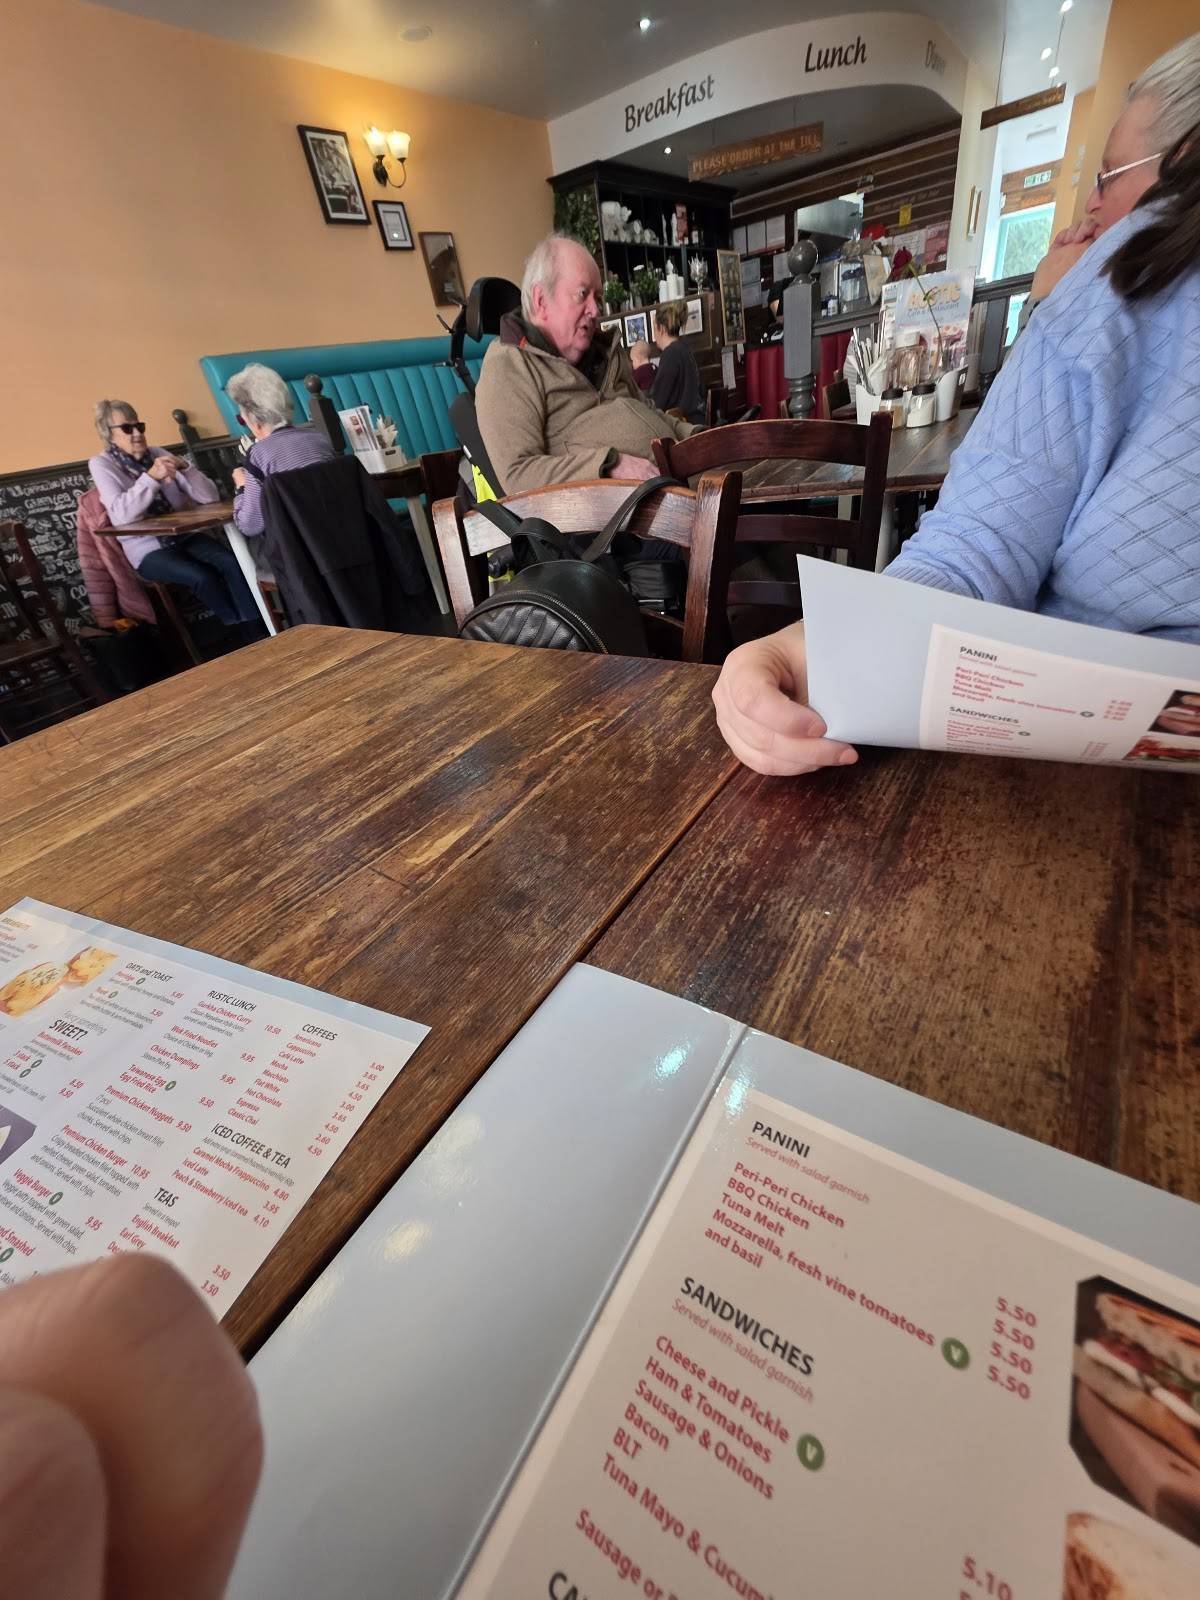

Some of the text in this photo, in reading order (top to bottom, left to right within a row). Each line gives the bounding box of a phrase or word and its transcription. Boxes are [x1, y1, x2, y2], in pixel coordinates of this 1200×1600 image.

[804, 36, 867, 73] Lunch
[624, 74, 715, 133] Breakfast
[692, 154, 727, 173] PLEASE
[960, 646, 998, 661] PANINI
[949, 706, 1020, 724] SANDWICHES
[152, 970, 174, 983] TOAST
[208, 990, 257, 1012] RUSTIC LUNCH
[215, 1007, 238, 1019] Chicken
[236, 1014, 253, 1025] Curry
[264, 1024, 283, 1035] 10.50
[49, 1019, 88, 1041] SWEET?
[294, 1034, 322, 1048] Americano
[302, 1023, 338, 1042] COFFEES
[150, 1044, 236, 1085] Chicken Dumplings 9.95
[240, 1052, 256, 1063] 9.95
[286, 1042, 378, 1081] Cappuccino 3.65
[290, 1054, 305, 1065] Latte
[355, 1081, 370, 1091] 3.65
[119, 1072, 215, 1108] Egg Fried Rice 9.50
[154, 1075, 167, 1088] Egg
[254, 1078, 347, 1122] Flat White 3.65
[262, 1069, 355, 1112] Macchiato 3.00
[270, 1059, 363, 1101] Mocha 4.50
[105, 1085, 193, 1133] Premium Chicken Nuggets 9.50
[236, 1097, 331, 1145] Espresso 2.60
[245, 1087, 339, 1134] Hot Chocolate 4.50
[62, 1124, 151, 1180] Premium Chicken Burger 10.95
[211, 1122, 292, 1169] ICED COFFEE & TEA
[227, 1107, 323, 1157] Classic Chai 4.50
[752, 1121, 811, 1158] PANINI
[182, 1158, 281, 1215] Iced Latte 3.95
[193, 1146, 290, 1201] Caramel Mocha Frappuccino 4.80
[745, 1136, 871, 1204] Served with salad garnish
[13, 1167, 104, 1231] Veggie Burger 9.95
[27, 1193, 47, 1213] topped
[53, 1214, 71, 1232] green
[154, 1186, 180, 1207] TEAS
[172, 1170, 189, 1185] Peach
[192, 1180, 226, 1204] Strawberry
[223, 1196, 239, 1211] Iced
[237, 1204, 249, 1217] tea
[253, 1214, 270, 1229] 4.10
[721, 1192, 786, 1238] Tuna Melt
[727, 1176, 811, 1230] BBQ Chicken
[733, 1161, 845, 1229] Peri-Peri Chicken
[5, 1230, 36, 1257] Smashed
[119, 1227, 134, 1241] Earl
[130, 1235, 147, 1250] Grey
[131, 1214, 180, 1249] English Breakfast
[704, 1226, 764, 1269] and basil
[200, 1280, 220, 1297] 3.50
[212, 1264, 231, 1281] 3.50
[712, 1208, 784, 1261] Mozzarella,
[786, 1251, 822, 1282] fresh
[825, 1275, 857, 1301] vine
[859, 1292, 936, 1348] tomatoes
[680, 1276, 815, 1377] SANDWICHES
[995, 1296, 1038, 1328] 5.50
[671, 1297, 815, 1405] Served with salad garnish
[992, 1318, 1036, 1351] 5.50
[989, 1340, 1034, 1375] 5.50
[655, 1334, 707, 1383] Cheese
[707, 1375, 741, 1406] and
[739, 1395, 791, 1445] Pickle
[986, 1364, 1032, 1400] 5.50
[623, 1401, 670, 1452] Bacon
[645, 1355, 773, 1465] Ham & Tomatoes
[612, 1426, 643, 1460] BLT
[634, 1378, 775, 1501] Sausage & Onions
[602, 1451, 774, 1600] Tuna Mayo & Cucum
[575, 1508, 643, 1586] Sausage
[962, 1554, 1013, 1600] 5.10
